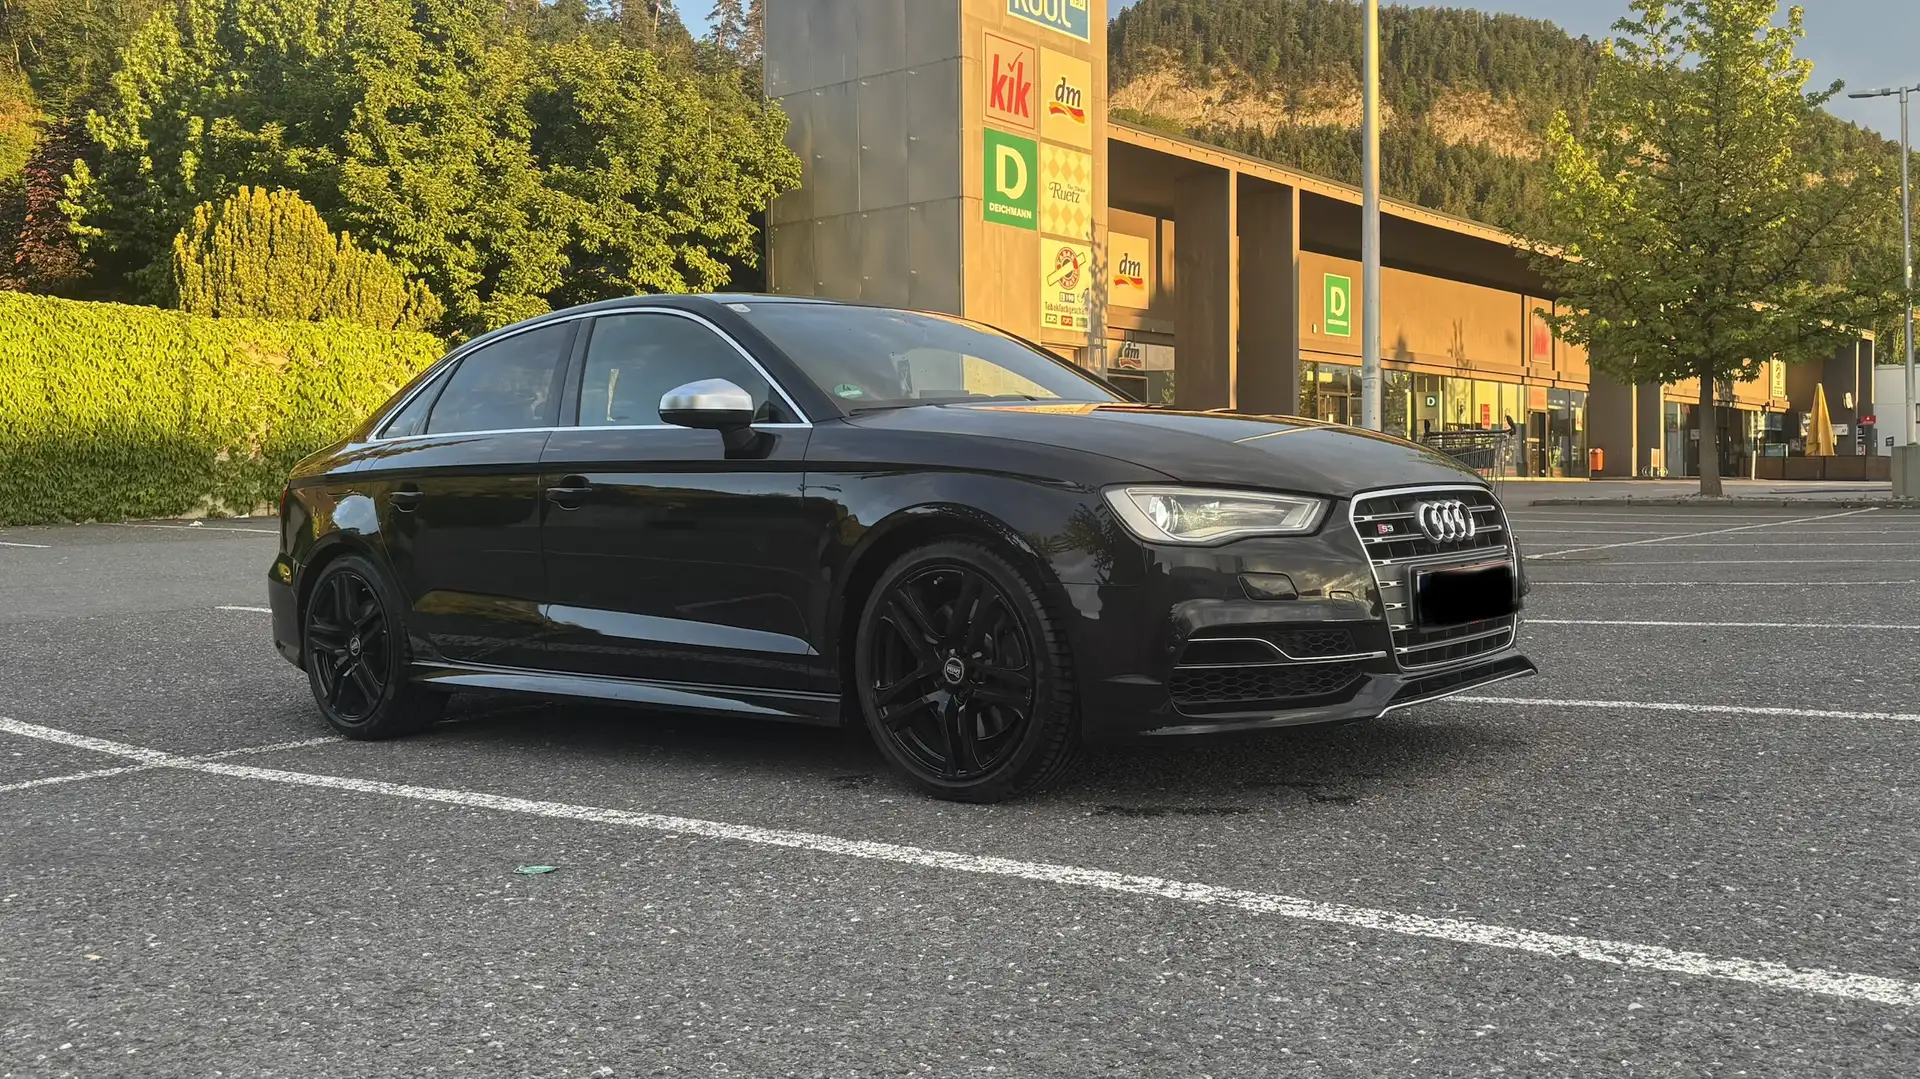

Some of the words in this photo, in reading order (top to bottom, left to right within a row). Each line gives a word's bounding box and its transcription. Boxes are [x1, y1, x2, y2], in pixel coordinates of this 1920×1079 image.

[990, 53, 1031, 118] kik
[1055, 76, 1081, 107] dm
[996, 144, 1027, 199] D
[1048, 181, 1080, 204] Ruetz
[989, 202, 1032, 219] DEICHMANN
[1119, 252, 1141, 277] dm
[1330, 286, 1346, 316] D
[1124, 343, 1140, 359] dm
[1426, 397, 1436, 406] D
[1381, 524, 1394, 533] S3
